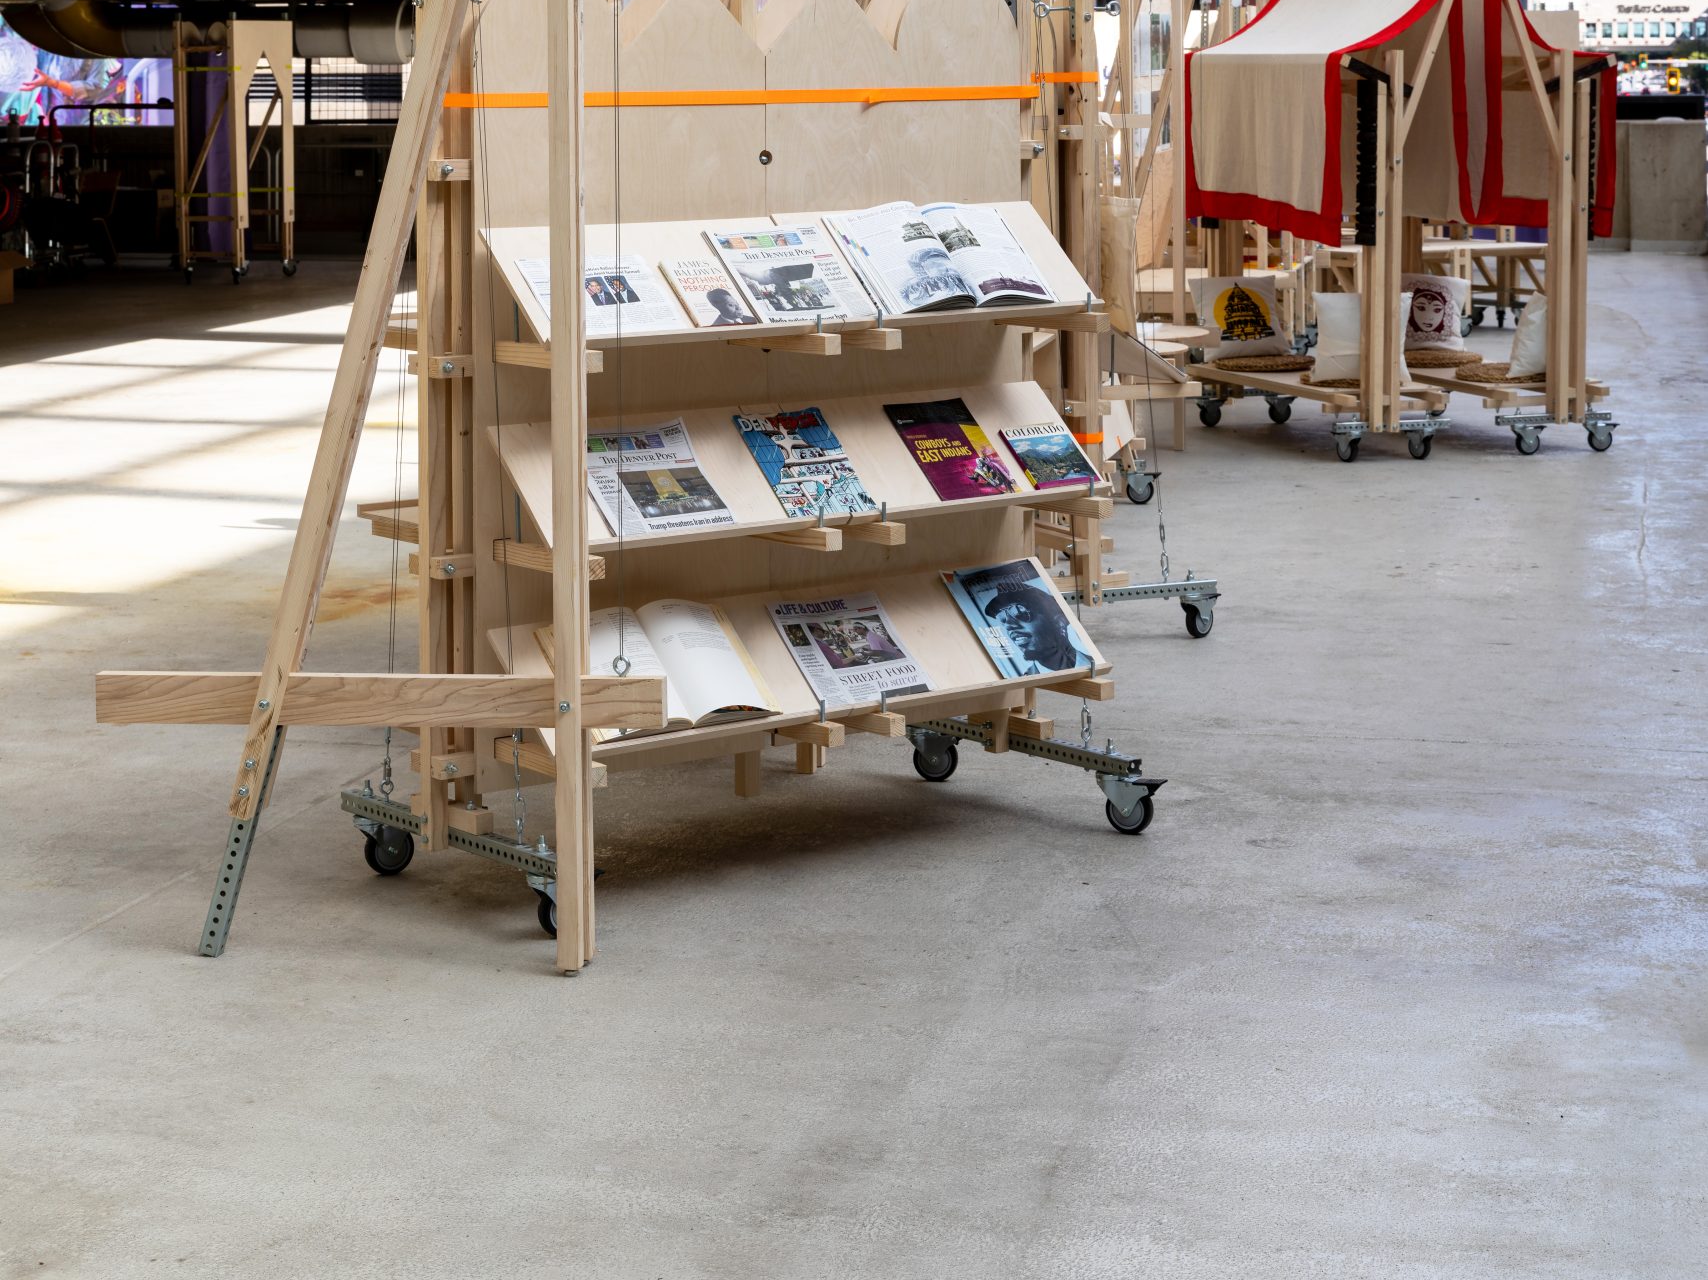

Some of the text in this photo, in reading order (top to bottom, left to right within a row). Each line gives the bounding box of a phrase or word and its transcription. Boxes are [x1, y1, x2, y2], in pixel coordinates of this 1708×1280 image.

[741, 248, 816, 260] THE DENVER POST
[678, 275, 727, 284] NOTHING
[1005, 424, 1065, 438] COLORADO
[915, 438, 951, 449] COWBOYS
[620, 453, 655, 464] DENVER
[655, 452, 678, 461] POST
[918, 446, 973, 463] EAST INDIANS
[779, 603, 799, 616] LIFE
[798, 603, 806, 614] &
[806, 599, 848, 614] CULTURE
[839, 664, 916, 685] STREET FOOD
[877, 674, 918, 689] to savor
